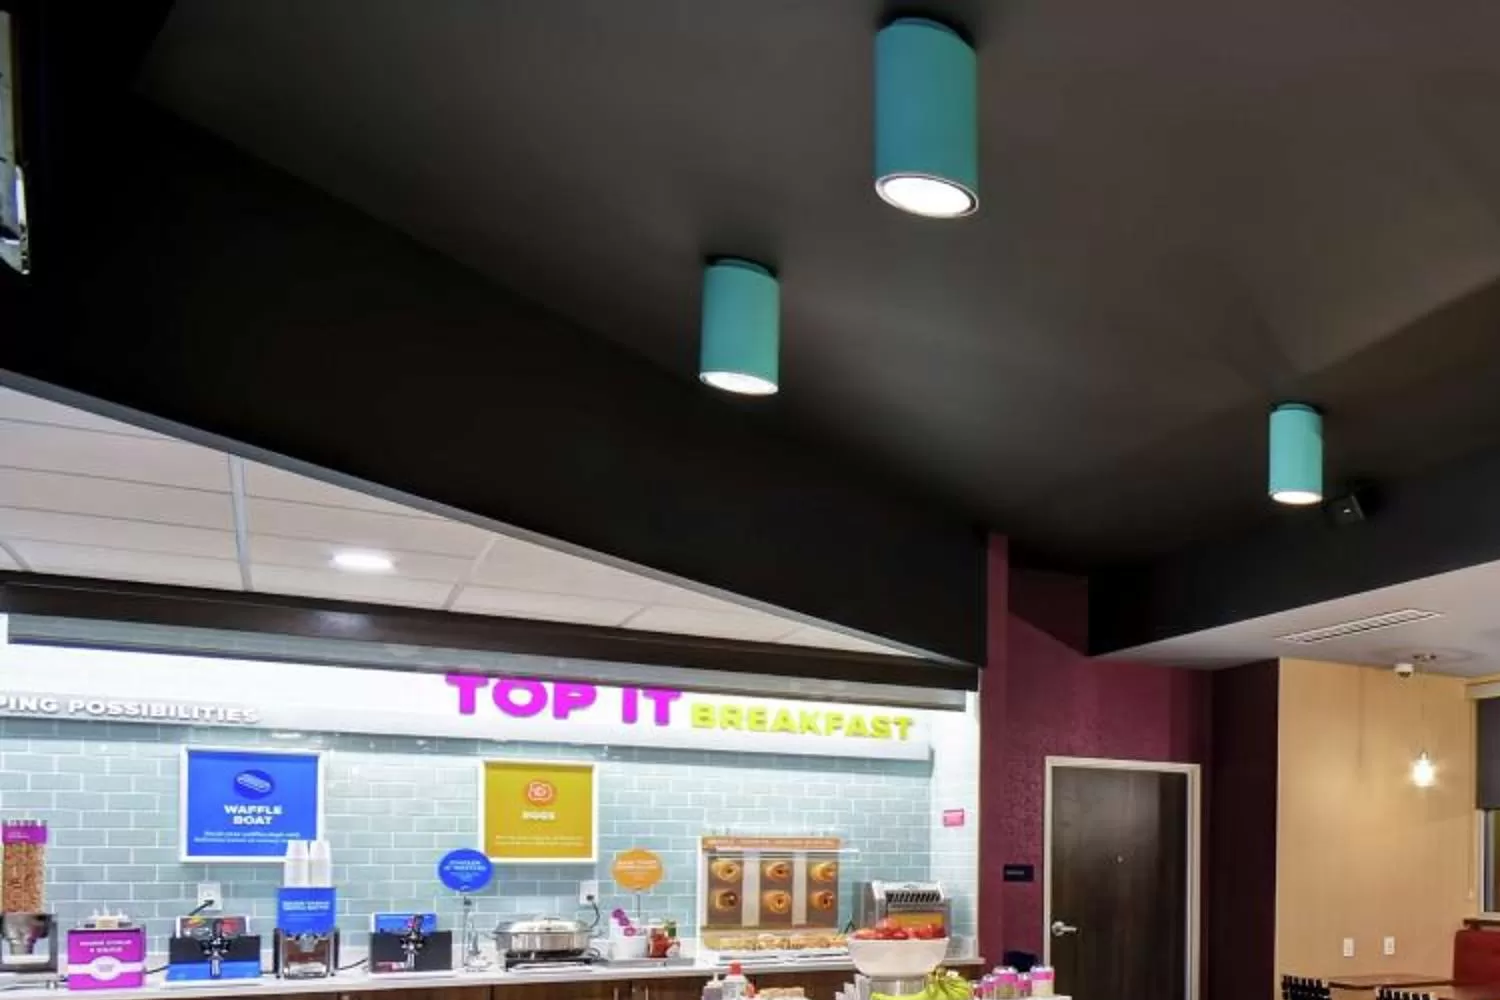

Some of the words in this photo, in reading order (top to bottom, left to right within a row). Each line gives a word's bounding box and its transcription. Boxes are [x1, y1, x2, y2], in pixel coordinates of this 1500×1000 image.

[67, 698, 261, 723] POSSIBILITIES
[445, 673, 598, 720] TOP
[621, 684, 683, 726] IT
[691, 703, 914, 740] BREAKFAST
[223, 804, 284, 815] WAFFLE
[232, 815, 273, 825] BOAT
